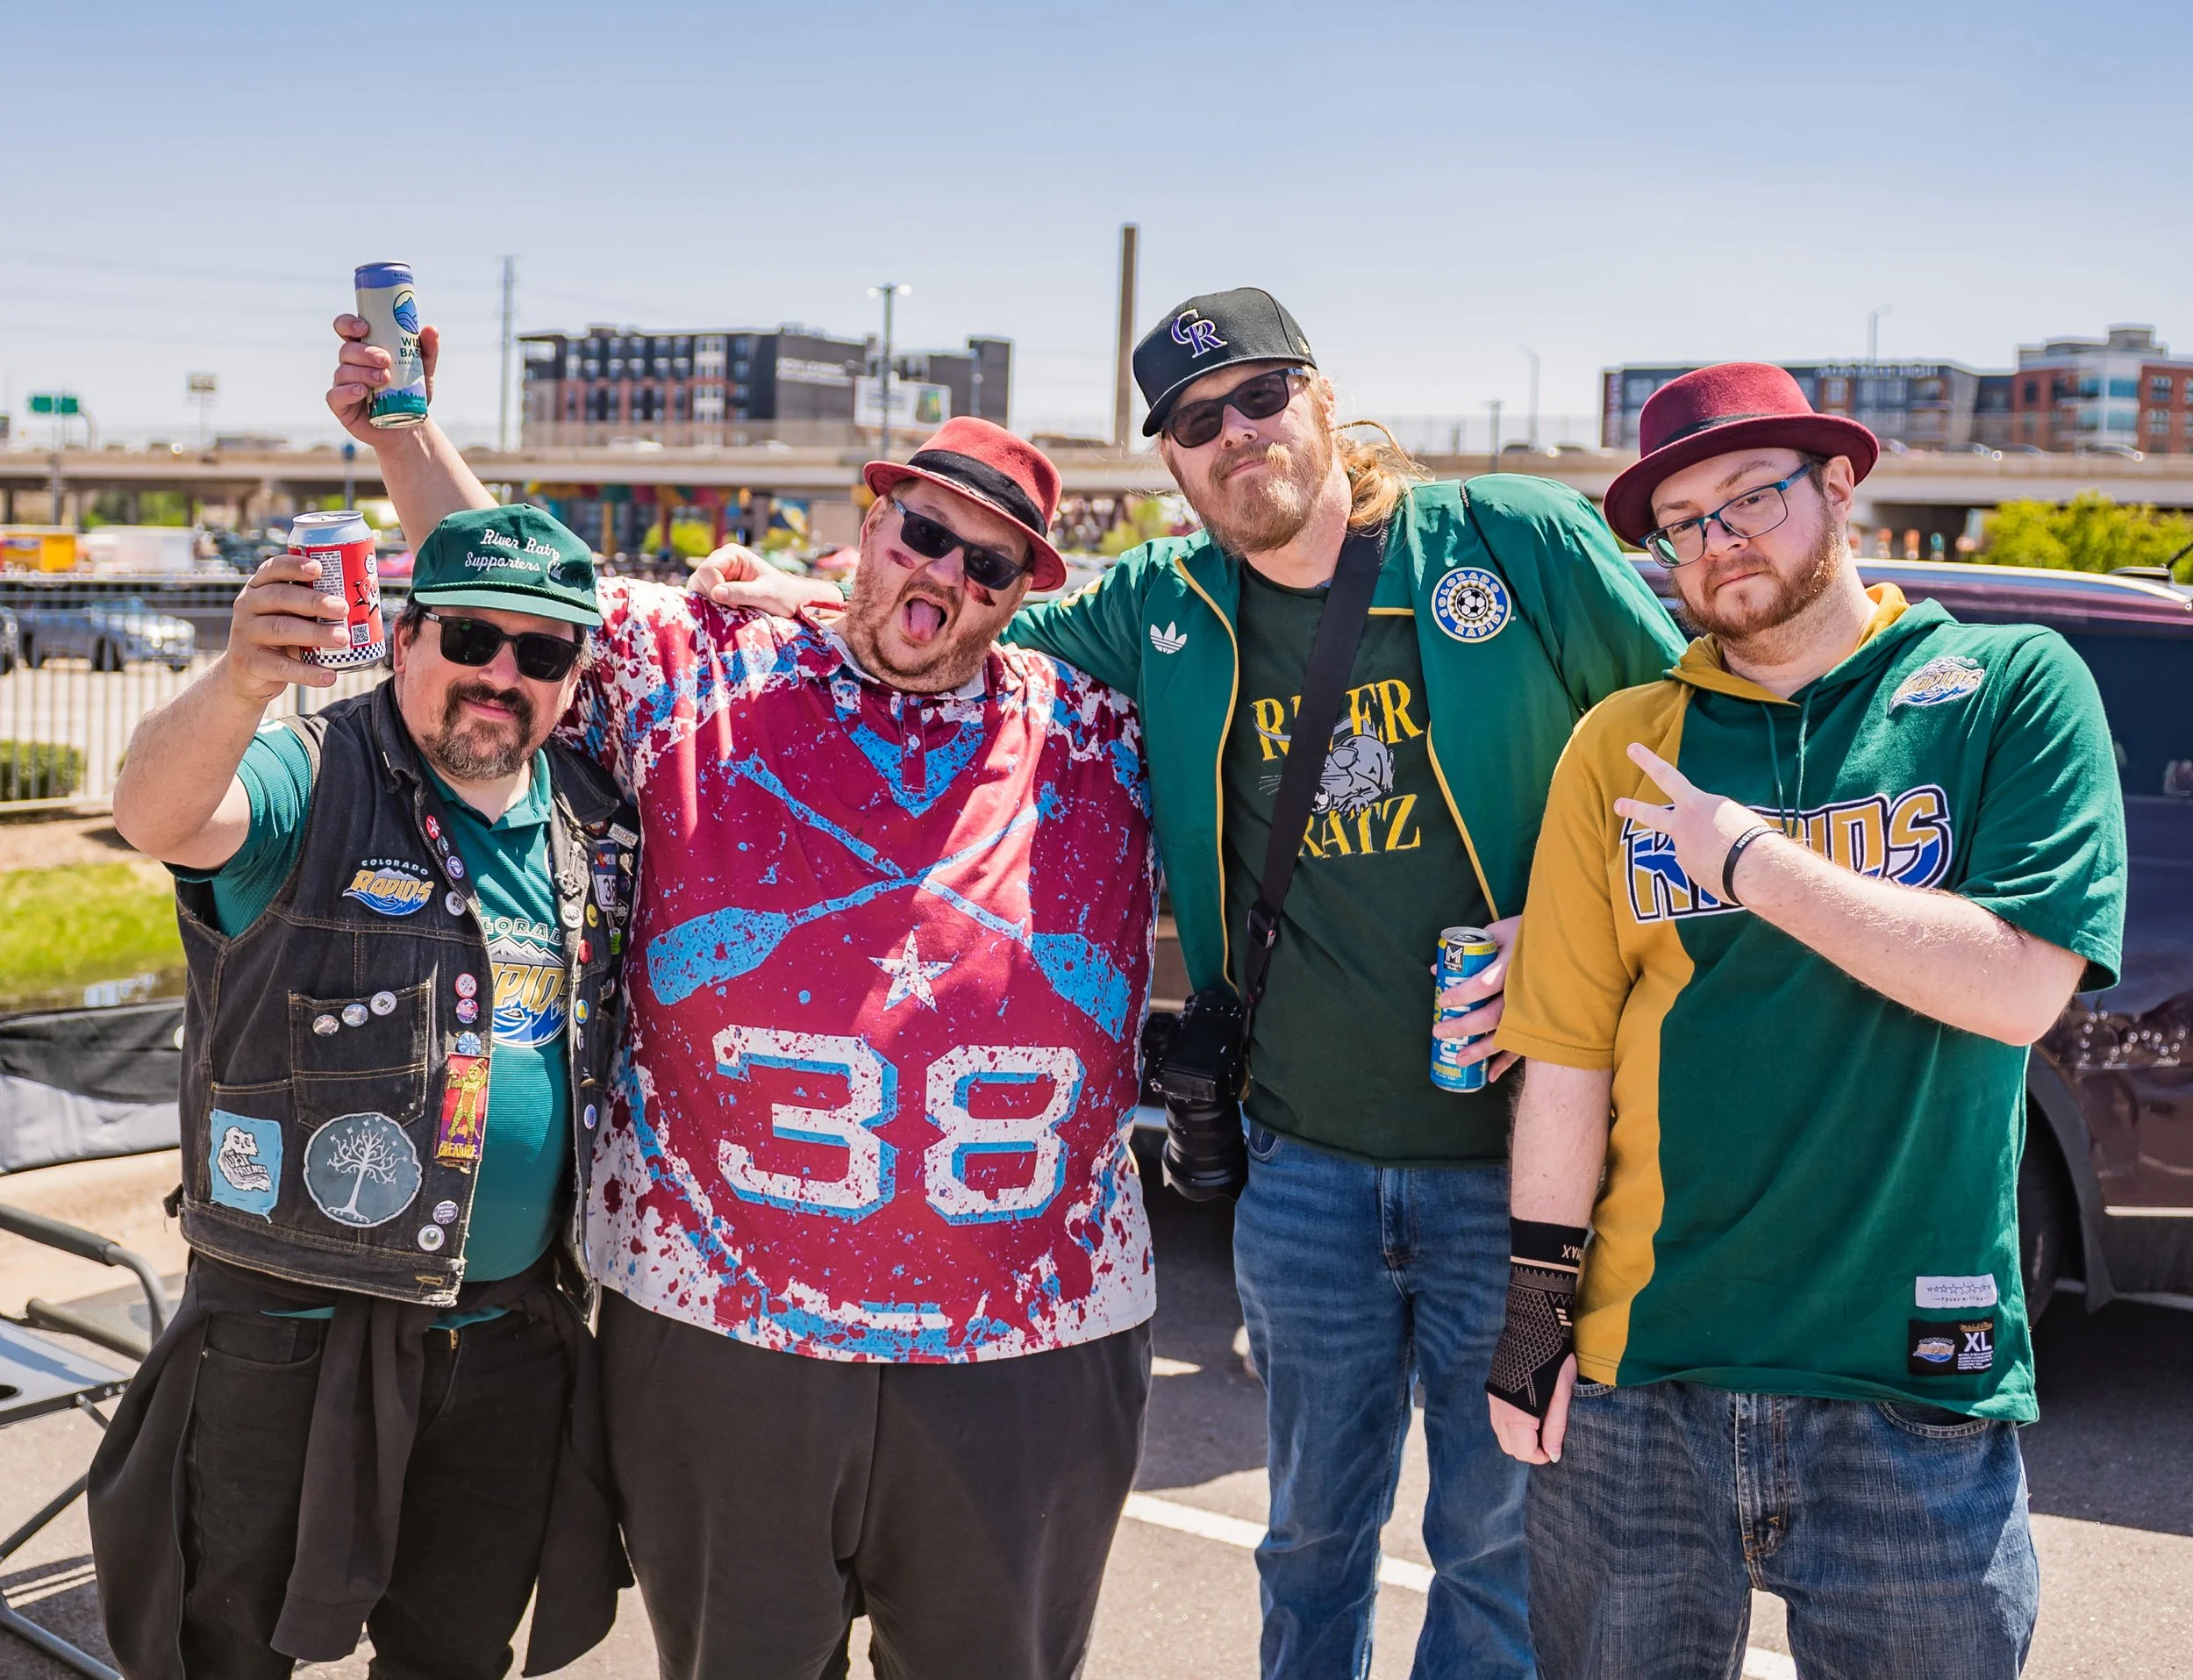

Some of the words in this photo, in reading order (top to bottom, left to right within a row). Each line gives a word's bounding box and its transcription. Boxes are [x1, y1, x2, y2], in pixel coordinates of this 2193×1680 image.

[400, 348, 421, 359] BAS
[401, 337, 421, 348] WIL
[480, 528, 519, 549] River
[465, 551, 540, 572] Supporters
[1439, 571, 1499, 618] COLORADO
[1454, 604, 1504, 638] RAPIDS
[1250, 678, 1424, 761] RER
[361, 858, 428, 876] COLORADO
[350, 869, 435, 902] RAPIDS
[480, 916, 562, 946] LORAD
[711, 1024, 1088, 1226] 38
[1964, 1331, 1992, 1352] XL
